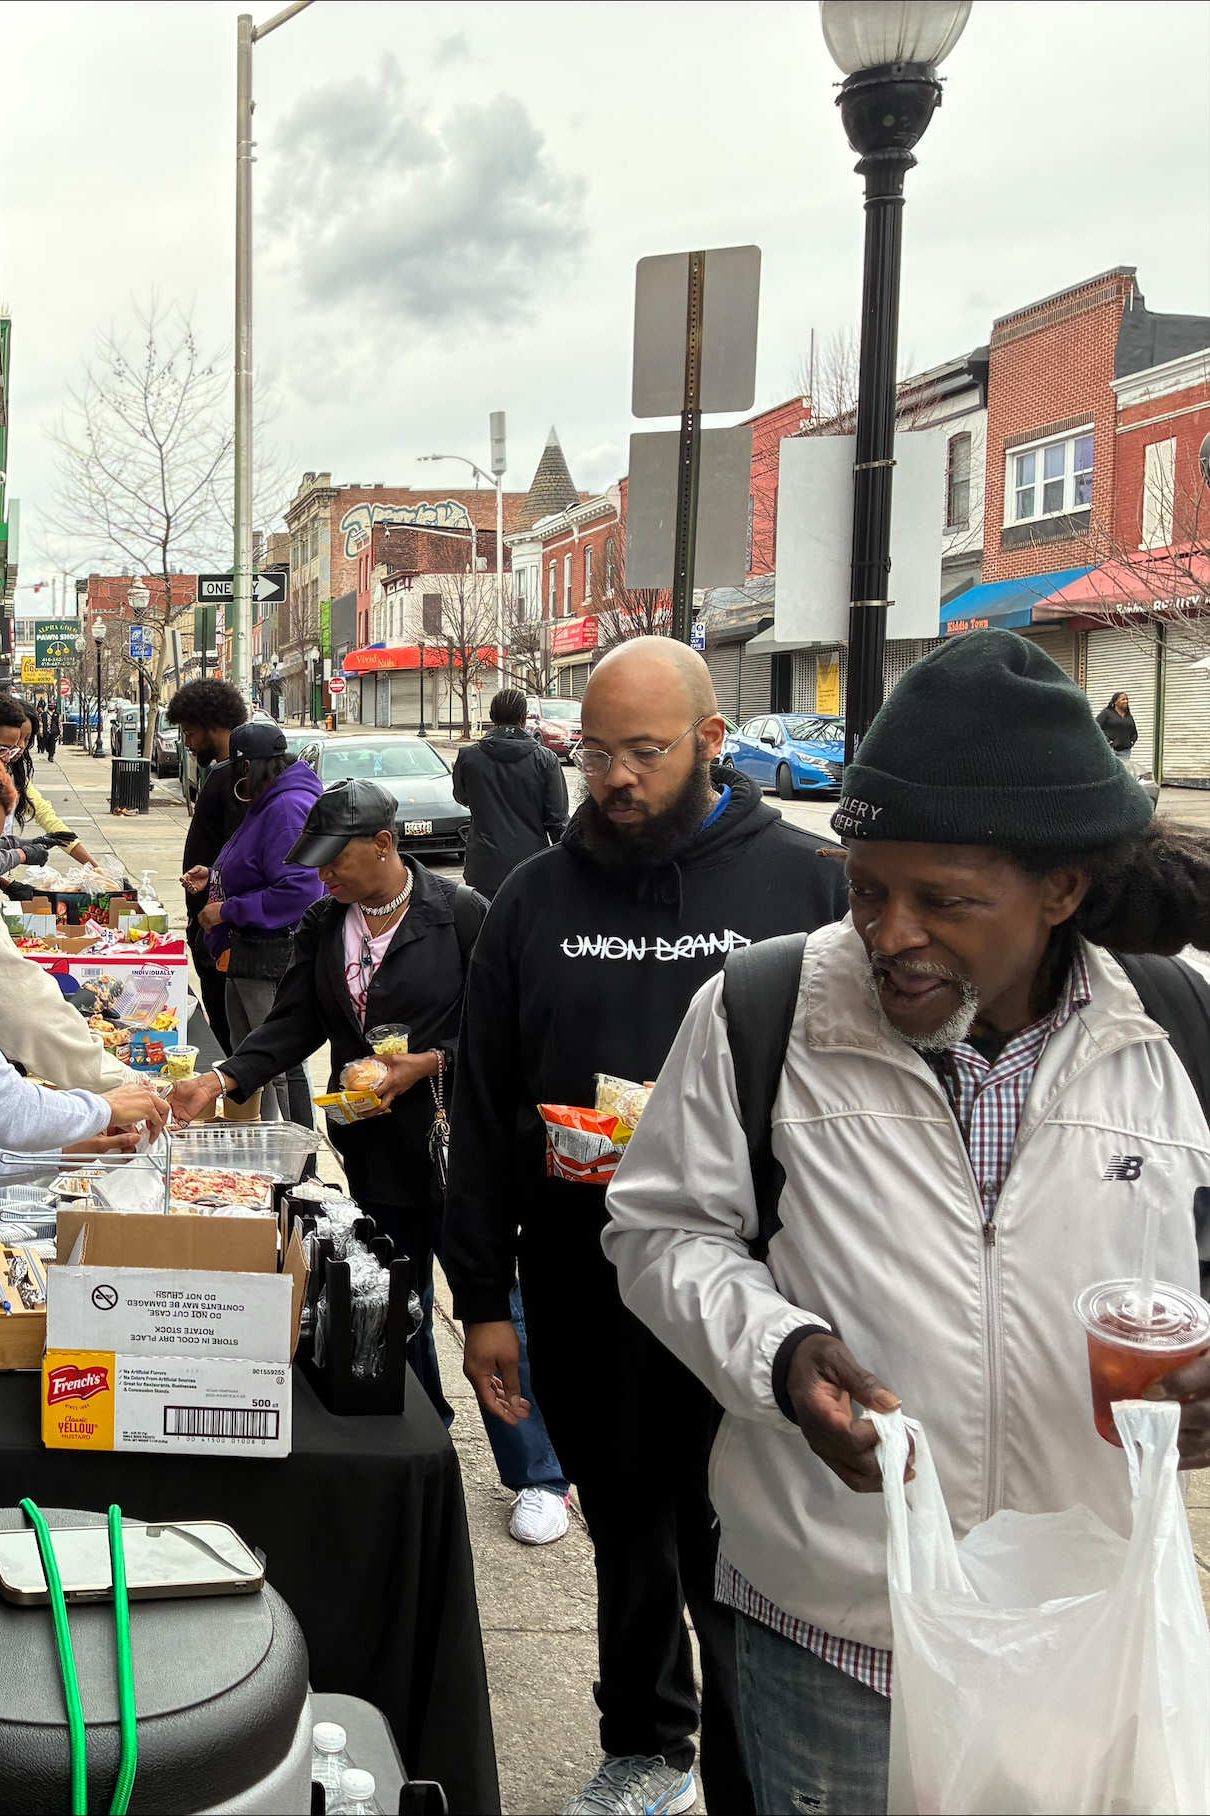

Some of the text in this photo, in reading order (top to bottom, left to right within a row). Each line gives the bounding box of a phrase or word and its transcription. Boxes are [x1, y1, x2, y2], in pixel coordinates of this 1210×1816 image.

[207, 583, 231, 594] ONE
[356, 654, 377, 664] Vivid
[378, 659, 394, 668] Nails
[560, 934, 646, 961] UNION
[154, 1326, 214, 1335] ROTATE STOCK
[52, 1373, 101, 1395] French's
[252, 1399, 271, 1408] 500
[58, 1422, 95, 1435] YELLOW
